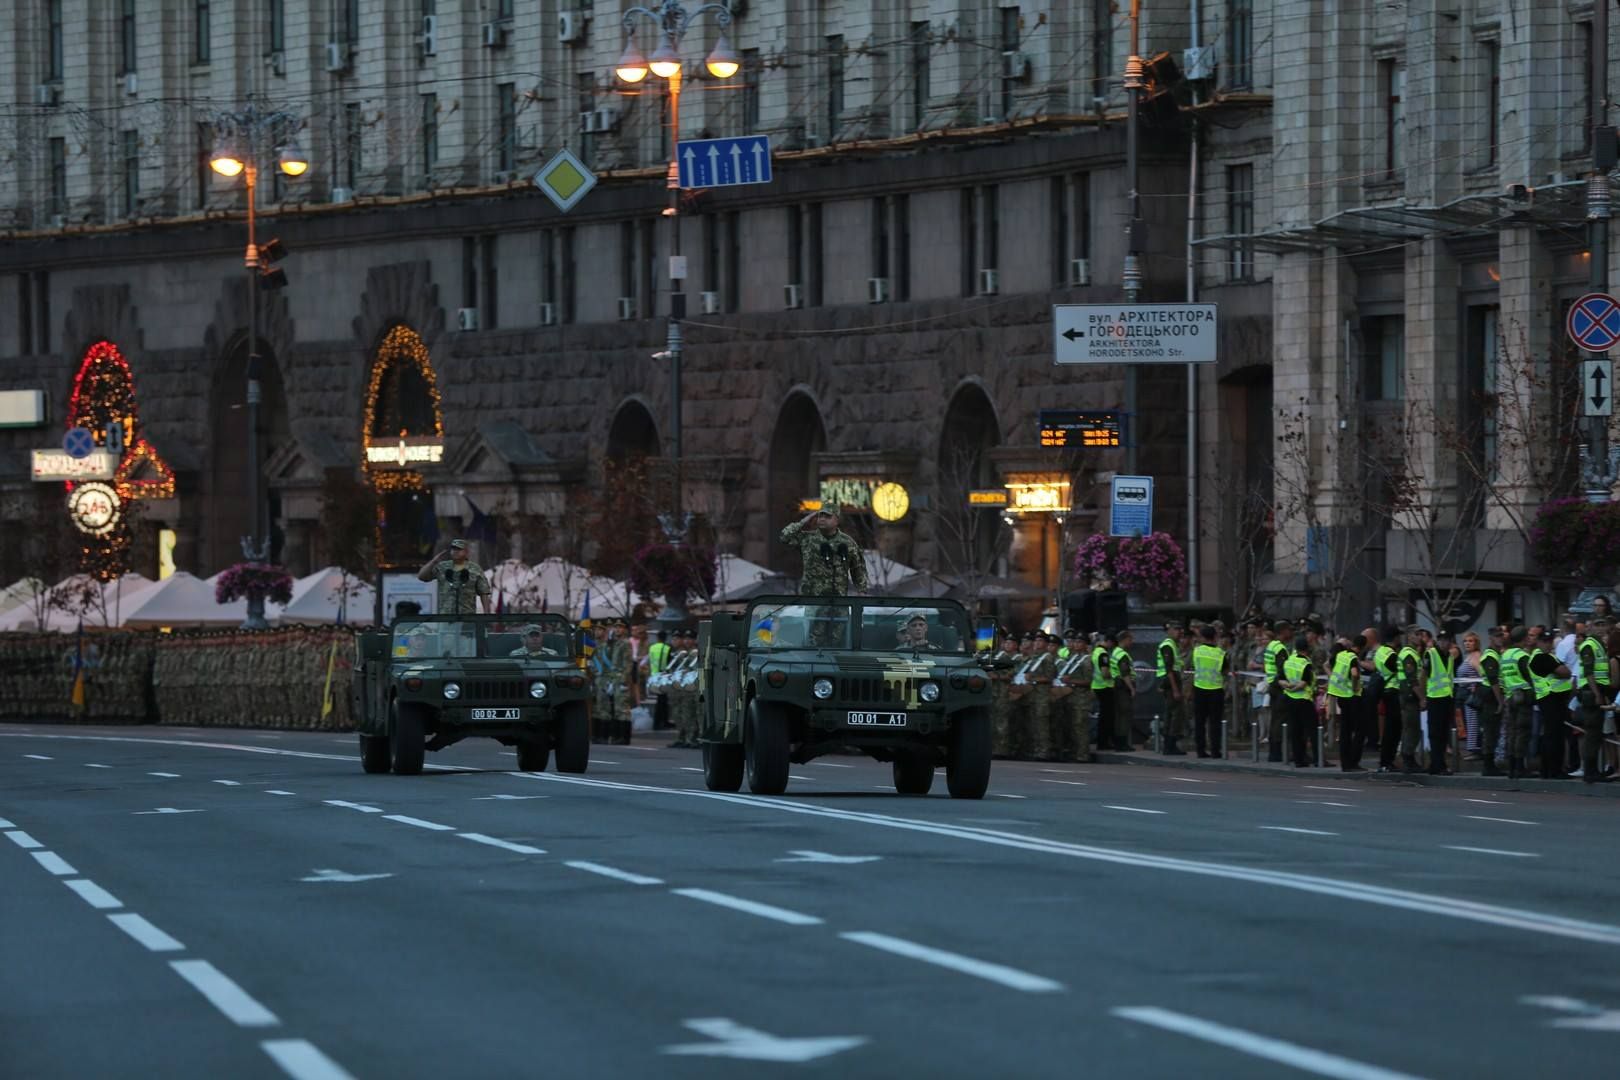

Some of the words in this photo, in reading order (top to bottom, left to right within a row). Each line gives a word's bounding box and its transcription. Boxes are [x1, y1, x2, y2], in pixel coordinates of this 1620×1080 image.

[1089, 314, 1113, 325] вул.
[1118, 310, 1214, 322] АРХІТЕКТОРА
[1089, 324, 1199, 338] ГОРОДЕЦЬКОГО
[1089, 339, 1161, 348] ARKHITEKTORA
[1089, 348, 1165, 357] HORODETSKOHO
[1167, 347, 1185, 357] Str.
